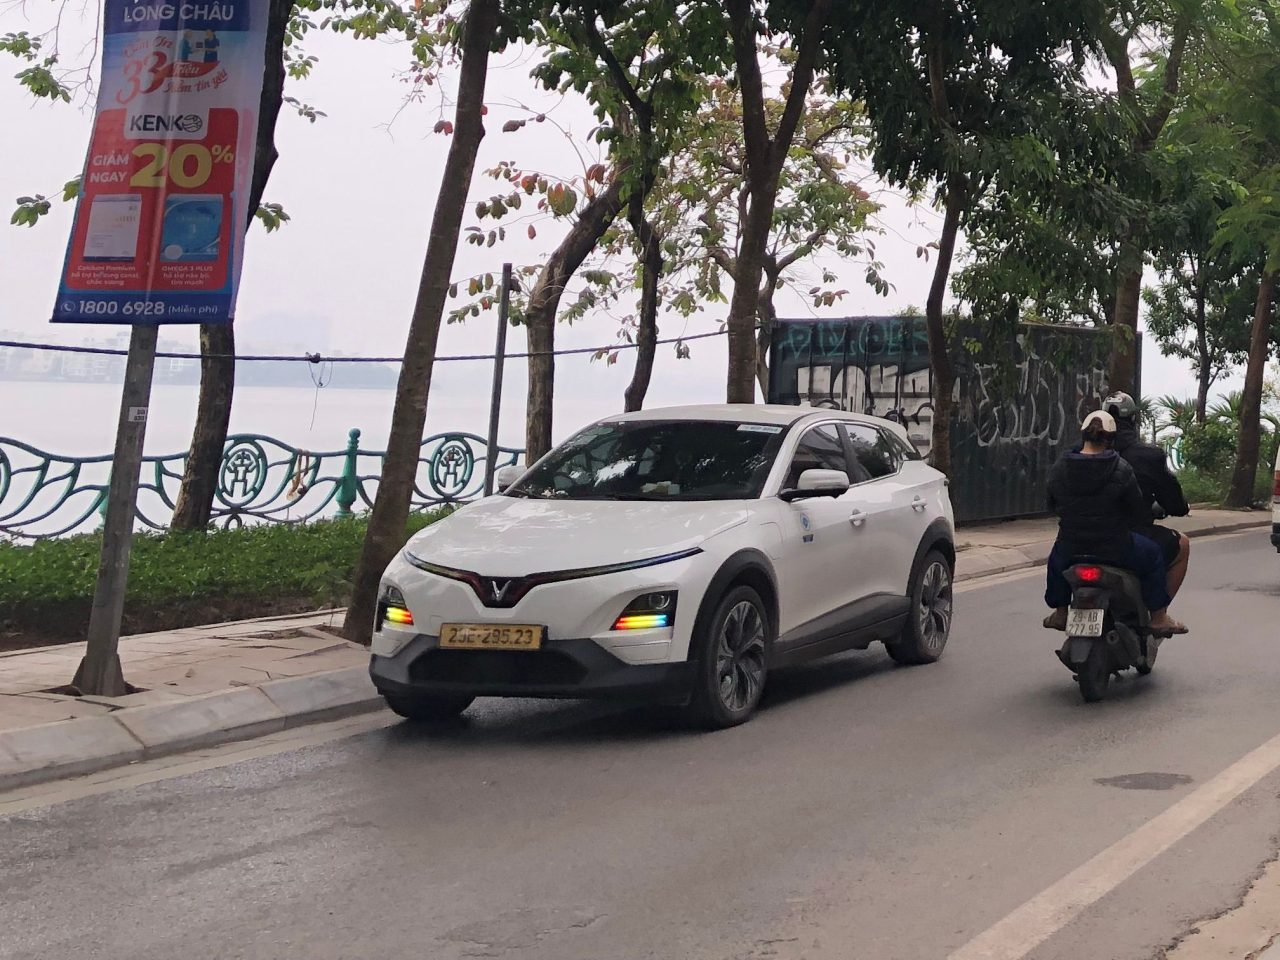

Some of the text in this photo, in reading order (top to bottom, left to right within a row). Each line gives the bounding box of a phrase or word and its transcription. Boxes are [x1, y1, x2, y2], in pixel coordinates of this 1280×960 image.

[124, 1, 234, 22] LONG CHÂU
[116, 50, 168, 104] 33
[92, 150, 129, 166] GIẢM
[90, 171, 128, 183] NGAY
[79, 300, 118, 314] 1800
[122, 300, 165, 316] 6928
